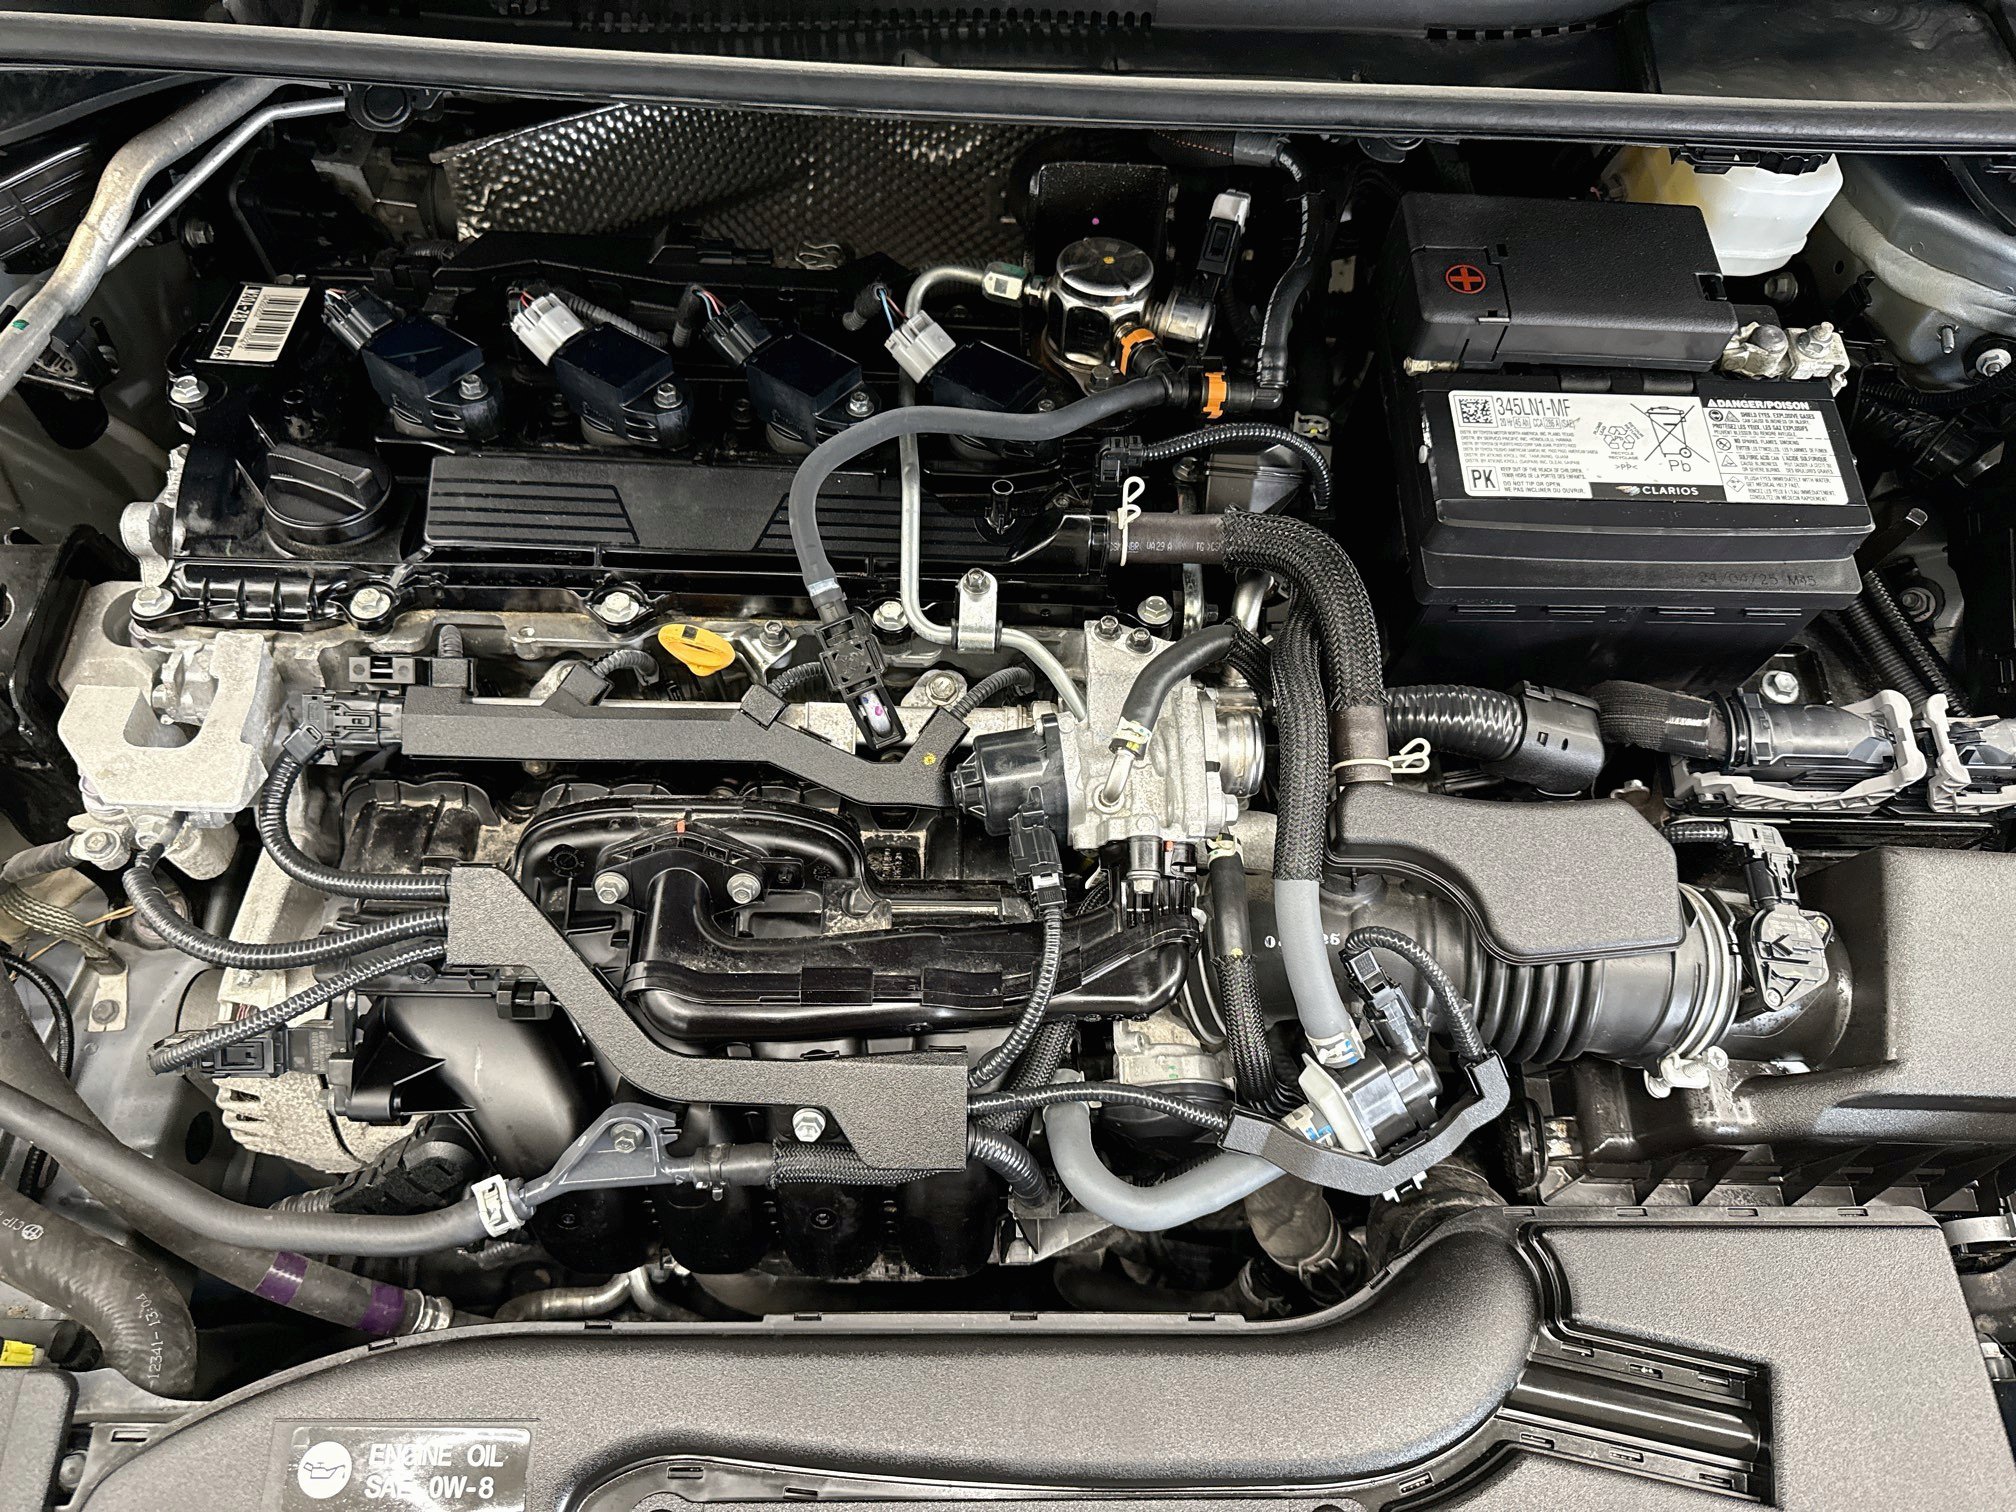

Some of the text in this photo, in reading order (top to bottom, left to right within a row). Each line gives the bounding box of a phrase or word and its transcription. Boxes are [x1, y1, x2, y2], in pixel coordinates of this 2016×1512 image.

[1496, 398, 1570, 416] 345LN1-MF
[1717, 400, 1810, 410] DANGER/POISON
[1668, 460, 1691, 472] Pb
[1471, 470, 1495, 488] PK
[1642, 486, 1699, 495] CLARIOS
[369, 1444, 503, 1467] ENGINE OIL
[364, 1475, 494, 1499] SAE 0W-8
